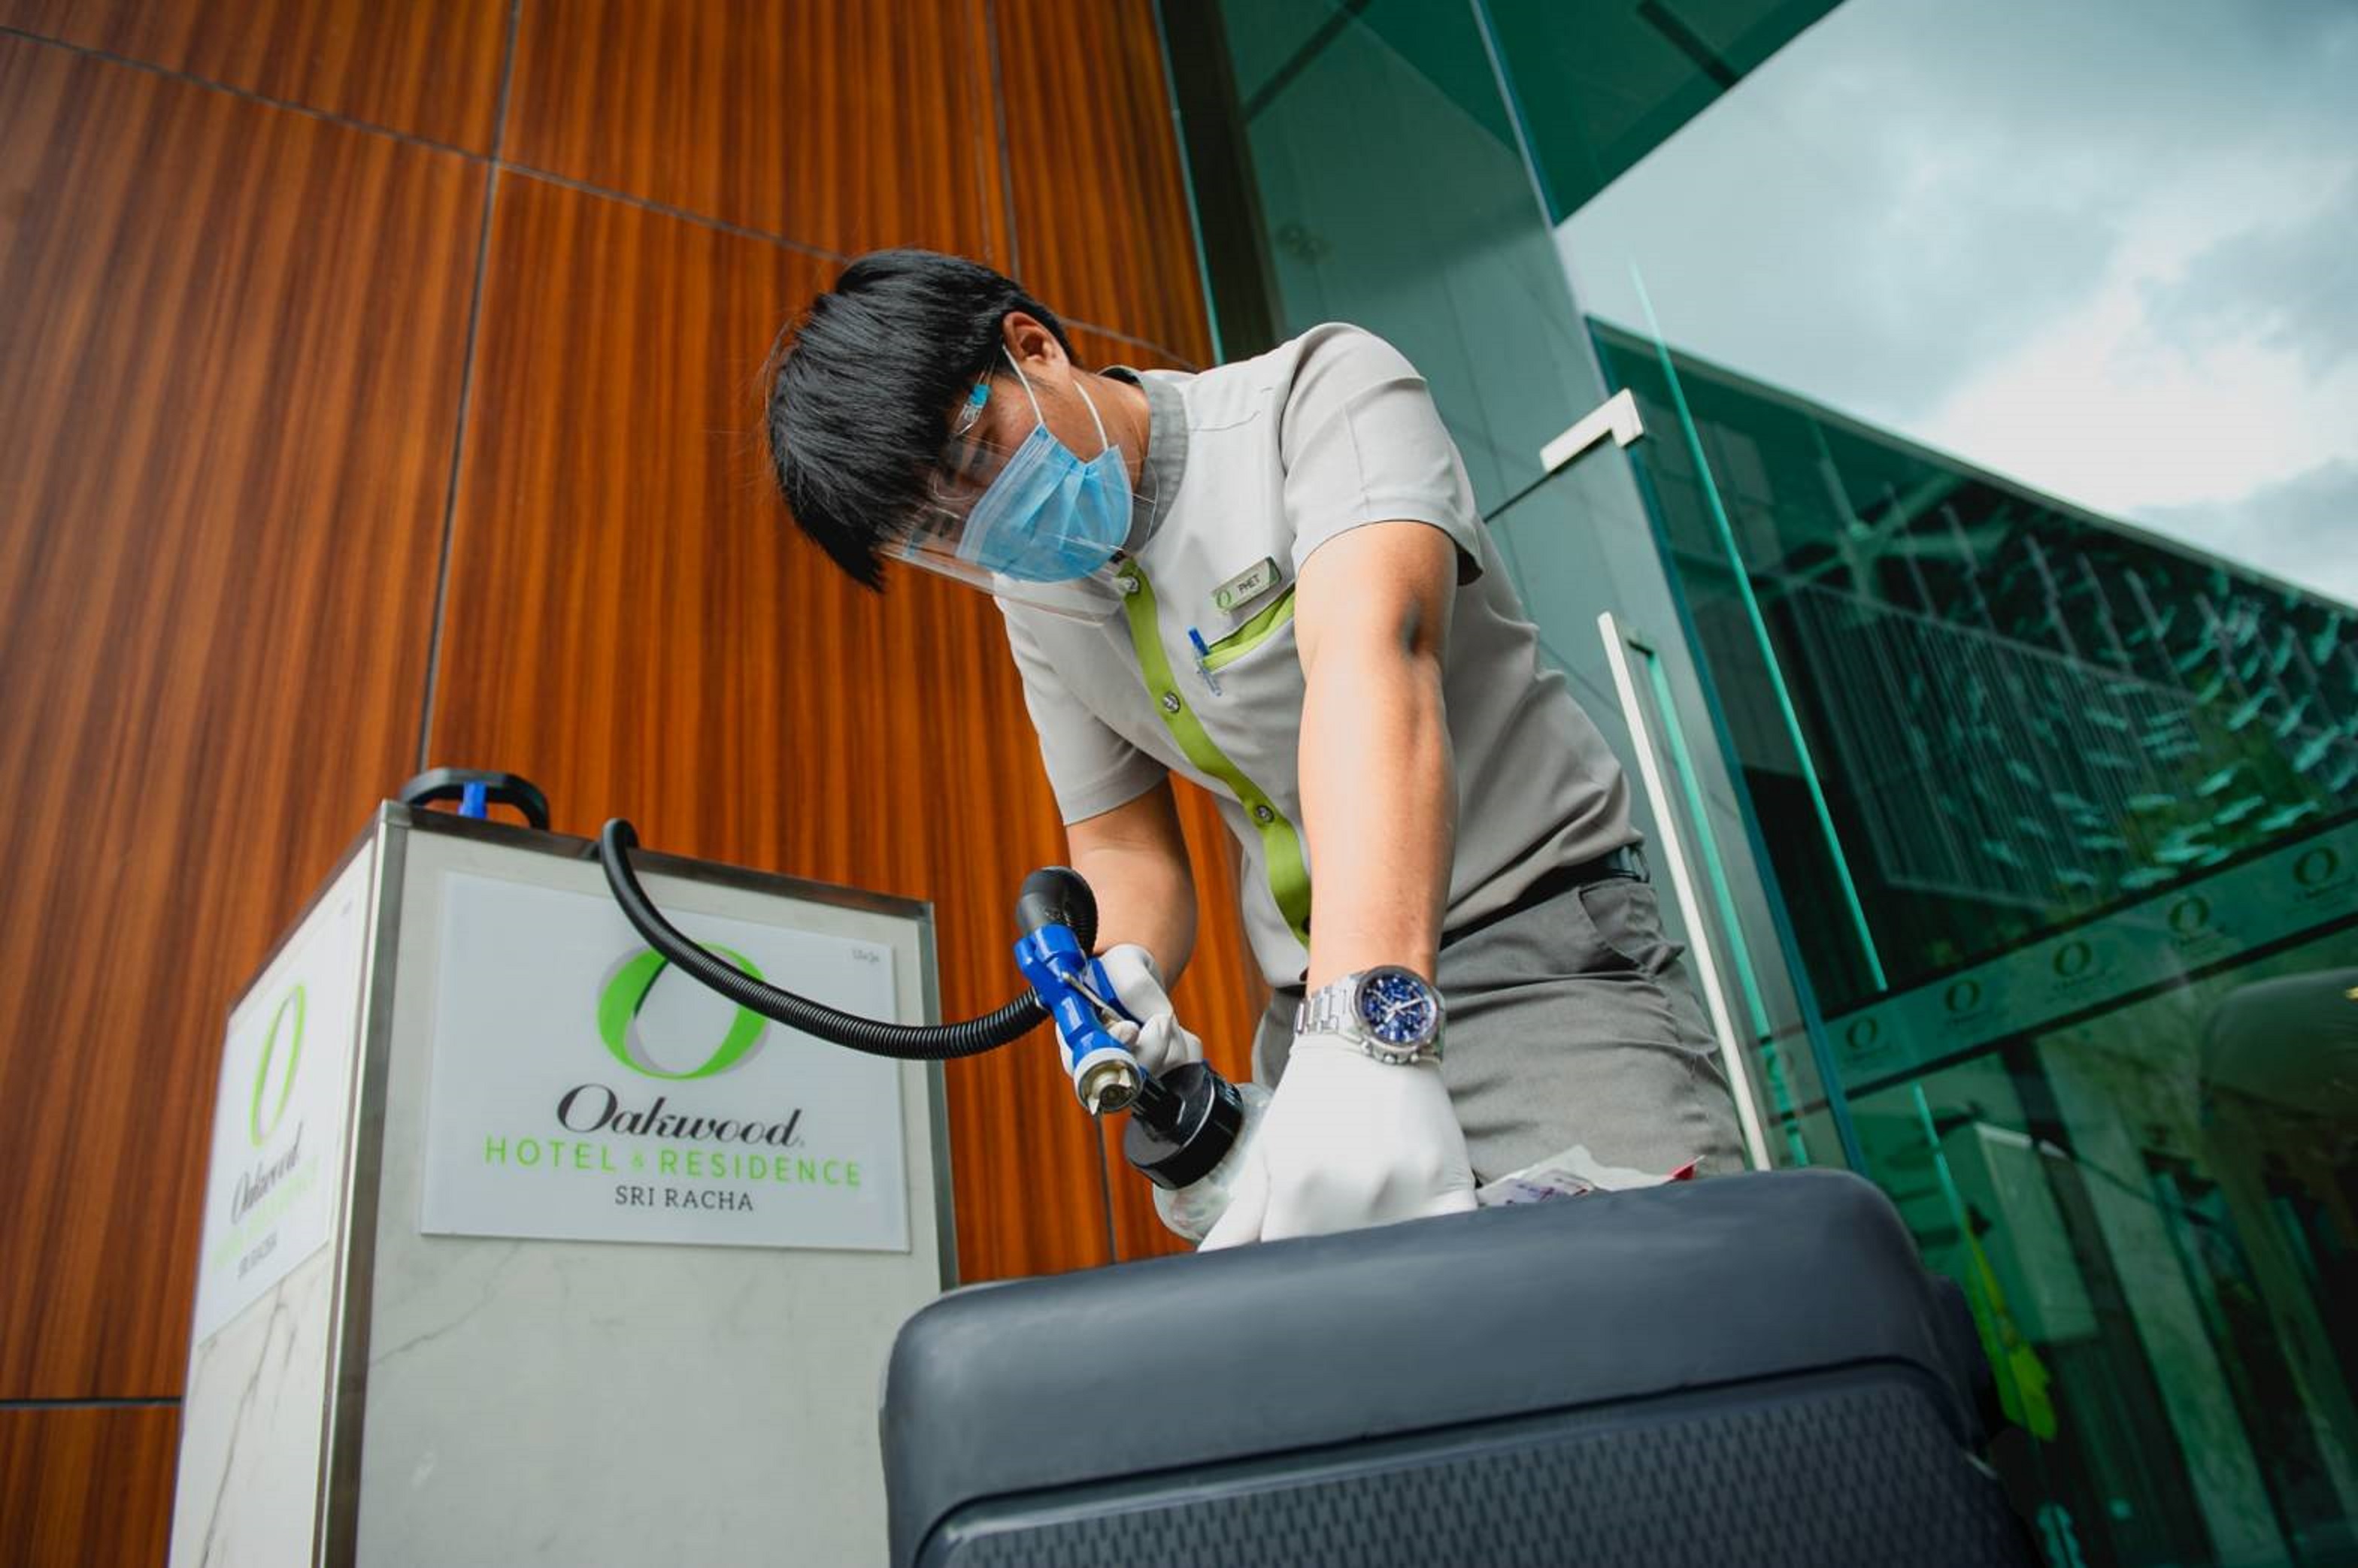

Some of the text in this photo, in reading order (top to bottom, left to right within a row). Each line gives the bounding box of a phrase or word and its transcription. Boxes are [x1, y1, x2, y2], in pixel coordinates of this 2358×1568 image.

[556, 1083, 802, 1147] Oakwood
[485, 1136, 617, 1172] HOTEL
[660, 1150, 861, 1186] RESIDENCE
[615, 1185, 753, 1211] SRI RACHA
